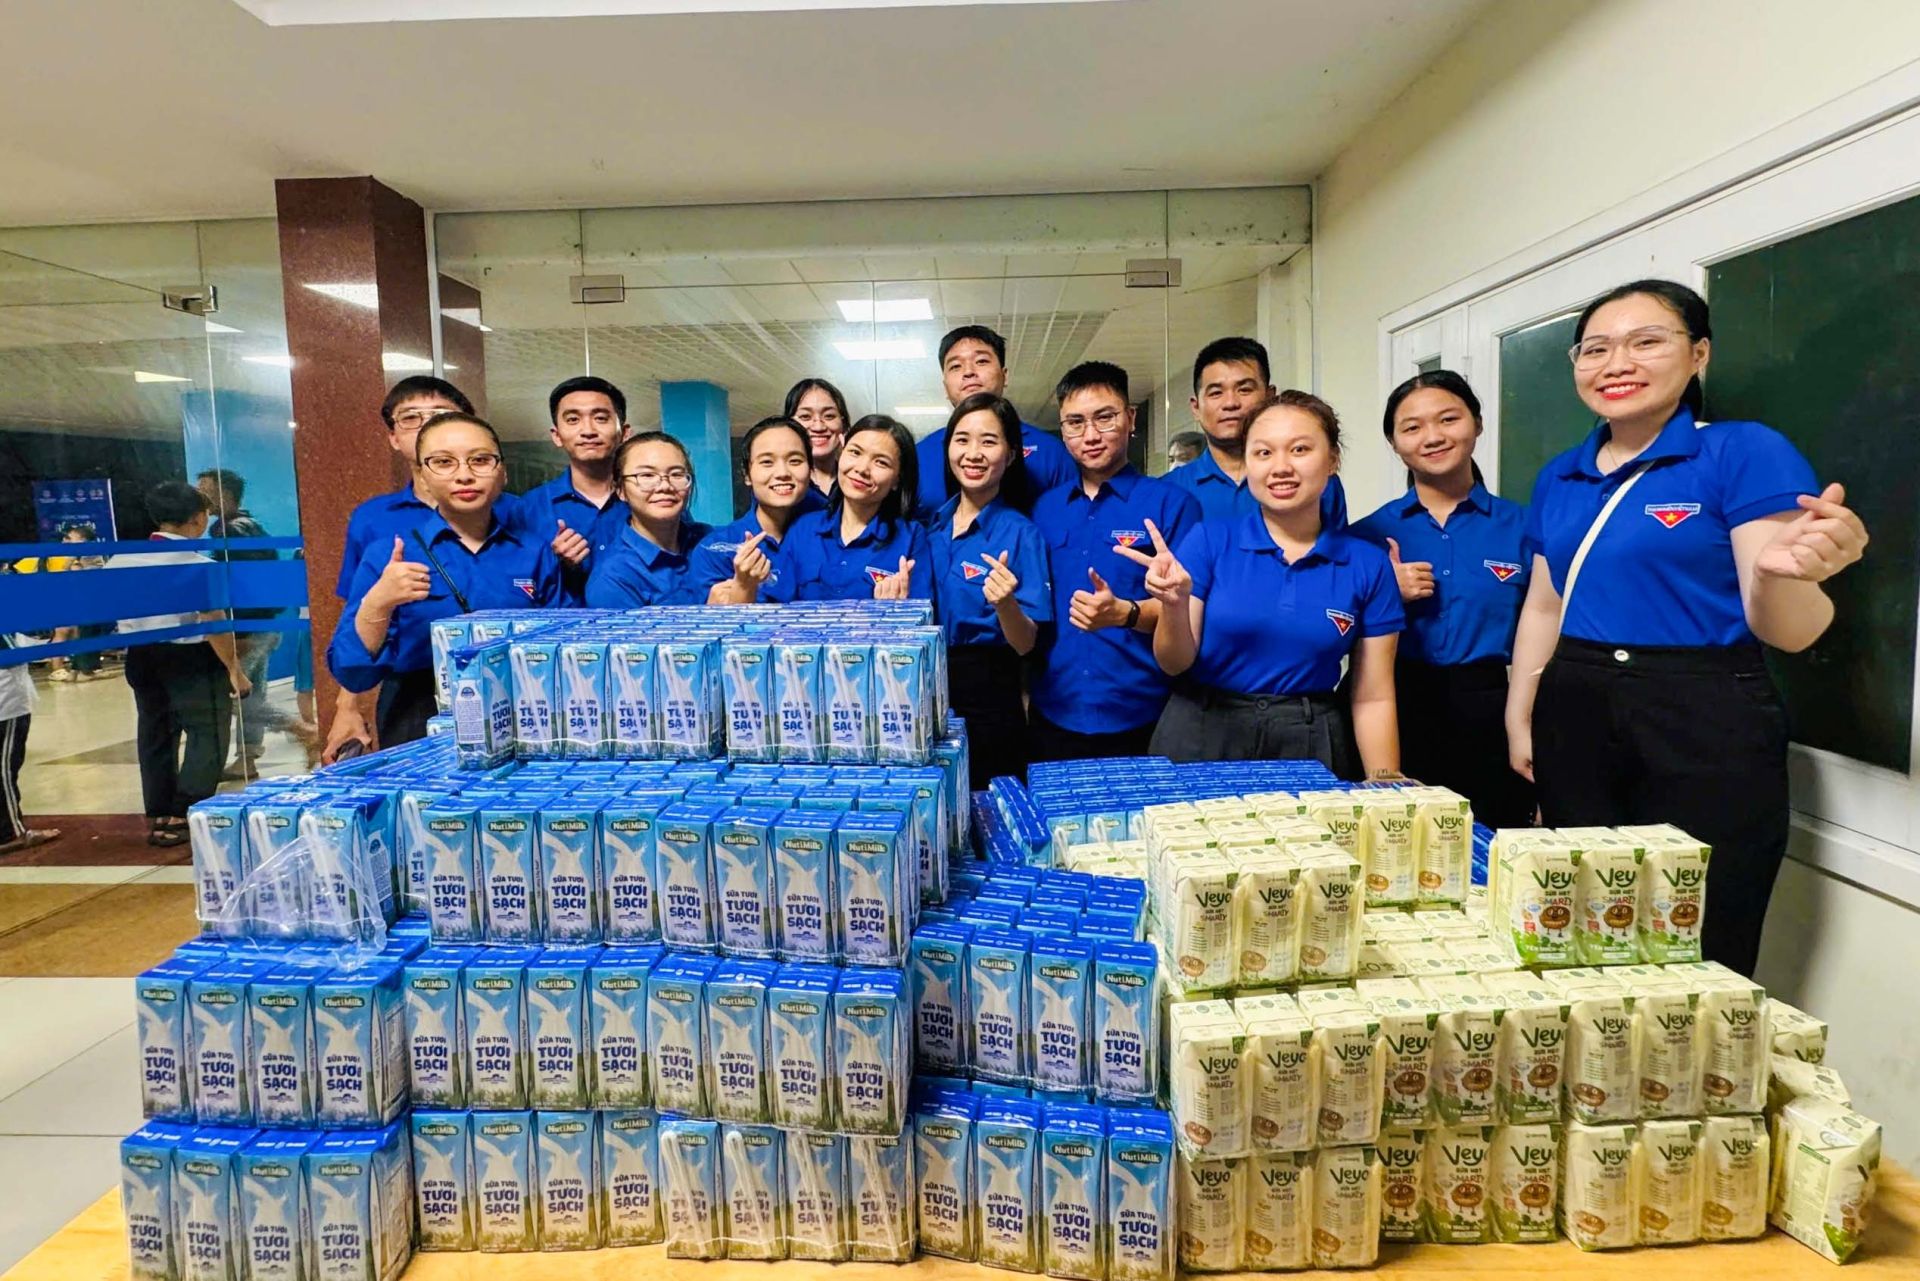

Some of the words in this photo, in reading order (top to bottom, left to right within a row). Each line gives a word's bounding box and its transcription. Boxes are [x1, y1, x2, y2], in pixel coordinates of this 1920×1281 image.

[431, 822, 465, 830] NutiMilk
[490, 822, 525, 830] NutiMilk
[613, 822, 648, 830] NutiMilk
[1328, 820, 1358, 836] Veyo
[1380, 819, 1411, 834] Veyo
[1433, 816, 1465, 832] Veyo
[665, 831, 700, 842] NutiMilk
[724, 834, 758, 846] NutiMilk
[785, 840, 820, 850] NutiMilk
[849, 843, 886, 853] NutiMilk
[1532, 869, 1577, 889] Vey
[1596, 869, 1636, 887] Vey
[1663, 867, 1703, 887] Vey
[433, 884, 465, 896] TƯƠI
[492, 885, 524, 896] TƯƠI
[552, 885, 585, 896] TƯƠI
[614, 885, 647, 896] TƯƠI
[1258, 887, 1294, 904] Veyo
[1320, 882, 1354, 900] Veyo
[434, 897, 466, 909] SẠCH
[493, 898, 525, 910] SẠCH
[553, 898, 586, 910] SẠCH
[615, 898, 647, 910] SẠCH
[668, 894, 700, 907] TƯƠI
[726, 899, 759, 912] TƯƠI
[1195, 892, 1232, 908] Veyo
[669, 906, 701, 919] SẠCH
[786, 904, 820, 918] TƯƠI
[849, 908, 884, 920] TƯƠI
[727, 912, 760, 926] SẠCH
[787, 917, 821, 931] SẠCH
[850, 920, 884, 934] SẠCH
[922, 951, 953, 962] NutiMilk
[980, 960, 1014, 970] NutiMilk
[1042, 967, 1078, 978] NutiMilk
[414, 980, 448, 988] NutiMilk
[476, 980, 511, 989] NutiMilk
[539, 980, 574, 989] NutiMilk
[602, 980, 639, 989] NutiMilk
[1107, 975, 1143, 985] NutiMilk
[659, 991, 692, 1001] NutiMilk
[719, 997, 755, 1006] NutiMilk
[781, 1004, 817, 1013] NutiMilk
[847, 1007, 885, 1016] NutiMilk
[921, 1012, 953, 1026] TƯƠI
[922, 1024, 953, 1039] SẠCH
[980, 1022, 1012, 1036] TƯƠI
[980, 1035, 1012, 1049] SẠCH
[1041, 1031, 1075, 1046] TƯƠI
[414, 1046, 447, 1057] TƯƠI
[475, 1045, 510, 1058] TƯƠI
[538, 1046, 572, 1058] TƯƠI
[601, 1046, 636, 1058] TƯƠI
[1041, 1044, 1075, 1059] SẠCH
[1105, 1040, 1140, 1054] TƯƠI
[1335, 1044, 1372, 1060] Veyo
[145, 1057, 175, 1070] TƯƠI
[415, 1059, 448, 1072] SẠCH
[476, 1060, 510, 1072] SẠCH
[538, 1060, 573, 1072] SẠCH
[602, 1059, 637, 1073] SẠCH
[660, 1055, 693, 1069] TƯƠI
[1105, 1052, 1140, 1067] SẠCH
[1199, 1056, 1238, 1073] Veyo
[1267, 1051, 1306, 1068] Veyo
[201, 1061, 234, 1074] TƯƠI
[262, 1064, 296, 1076] TƯƠI
[325, 1066, 361, 1077] TƯƠI
[720, 1062, 754, 1075] TƯƠI
[146, 1070, 176, 1084] SẠCH
[661, 1068, 693, 1082] SẠCH
[781, 1069, 816, 1082] TƯƠI
[846, 1073, 882, 1085] TƯƠI
[202, 1075, 234, 1089] SẠCH
[263, 1079, 296, 1091] SẠCH
[326, 1079, 362, 1092] SẠCH
[720, 1076, 754, 1089] SẠCH
[782, 1083, 816, 1097] SẠCH
[847, 1086, 883, 1100] SẠCH
[421, 1125, 456, 1134] NutiMilk
[484, 1125, 519, 1134] NutiMilk
[548, 1124, 584, 1133] NutiMilk
[614, 1119, 649, 1129] NutiMilk
[924, 1127, 960, 1138] NutiMilk
[988, 1137, 1025, 1147] NutiMilk
[1055, 1146, 1093, 1156] NutiMilk
[1121, 1153, 1159, 1162] NutiMilk
[1191, 1169, 1230, 1186] Veyo
[1261, 1170, 1299, 1186] Veyo
[1330, 1168, 1369, 1185] Veyo
[423, 1190, 456, 1201] TƯƠI
[484, 1190, 519, 1201] TƯƠI
[548, 1189, 582, 1200] TƯƠI
[613, 1183, 648, 1195] TƯƠI
[614, 1196, 649, 1209] SẠCH
[924, 1192, 958, 1209] TƯƠI
[424, 1203, 457, 1216] SẠCH
[485, 1203, 520, 1216] SẠCH
[548, 1202, 583, 1215] SẠCH
[924, 1204, 958, 1221] SẠCH
[987, 1203, 1022, 1219] TƯƠI
[988, 1216, 1022, 1233] SẠCH
[1053, 1213, 1089, 1229] TƯƠI
[1054, 1226, 1090, 1242] SẠCH
[1119, 1221, 1156, 1236] TƯƠI
[1119, 1235, 1157, 1249] SẠCH
[254, 1249, 290, 1263] SẠCH
[323, 1248, 360, 1260] SẠCH
